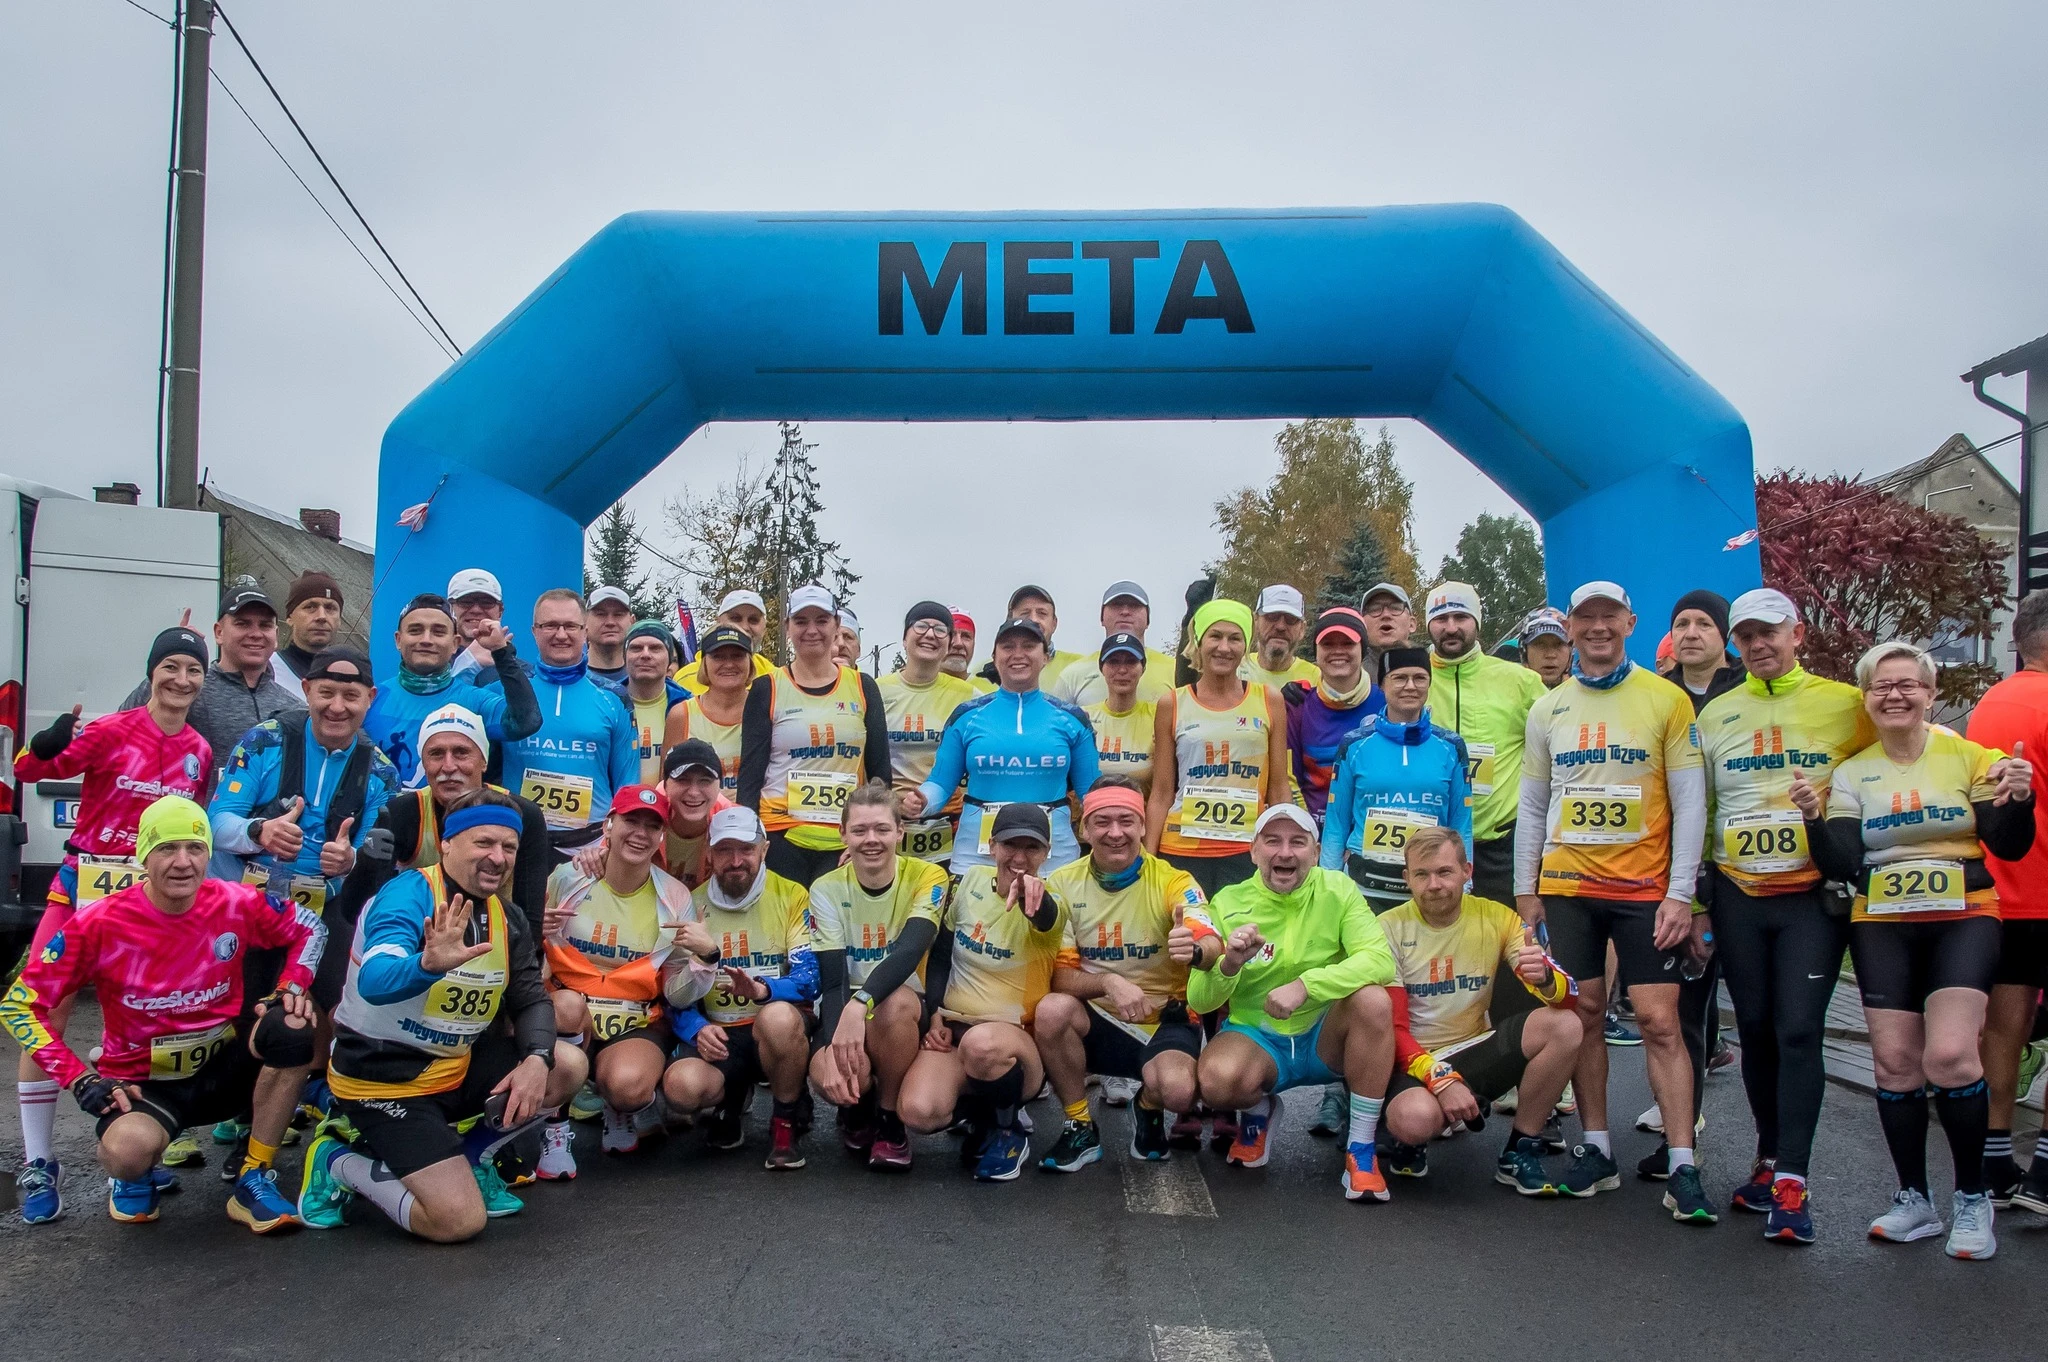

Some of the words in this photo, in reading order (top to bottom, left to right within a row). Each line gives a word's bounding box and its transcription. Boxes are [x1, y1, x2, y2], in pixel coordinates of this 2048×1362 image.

[878, 240, 1256, 335] META
[974, 755, 1067, 768] THALES
[531, 785, 581, 812] 255
[800, 785, 847, 808] 258
[1363, 792, 1443, 806] THALES
[1194, 801, 1246, 826] 202
[1571, 801, 1628, 827] 333
[1373, 823, 1420, 848] 25
[1736, 827, 1797, 857] 208
[93, 870, 149, 895] 44
[1883, 870, 1949, 897] 320
[440, 986, 494, 1016] 385
[169, 1038, 225, 1072] 190
